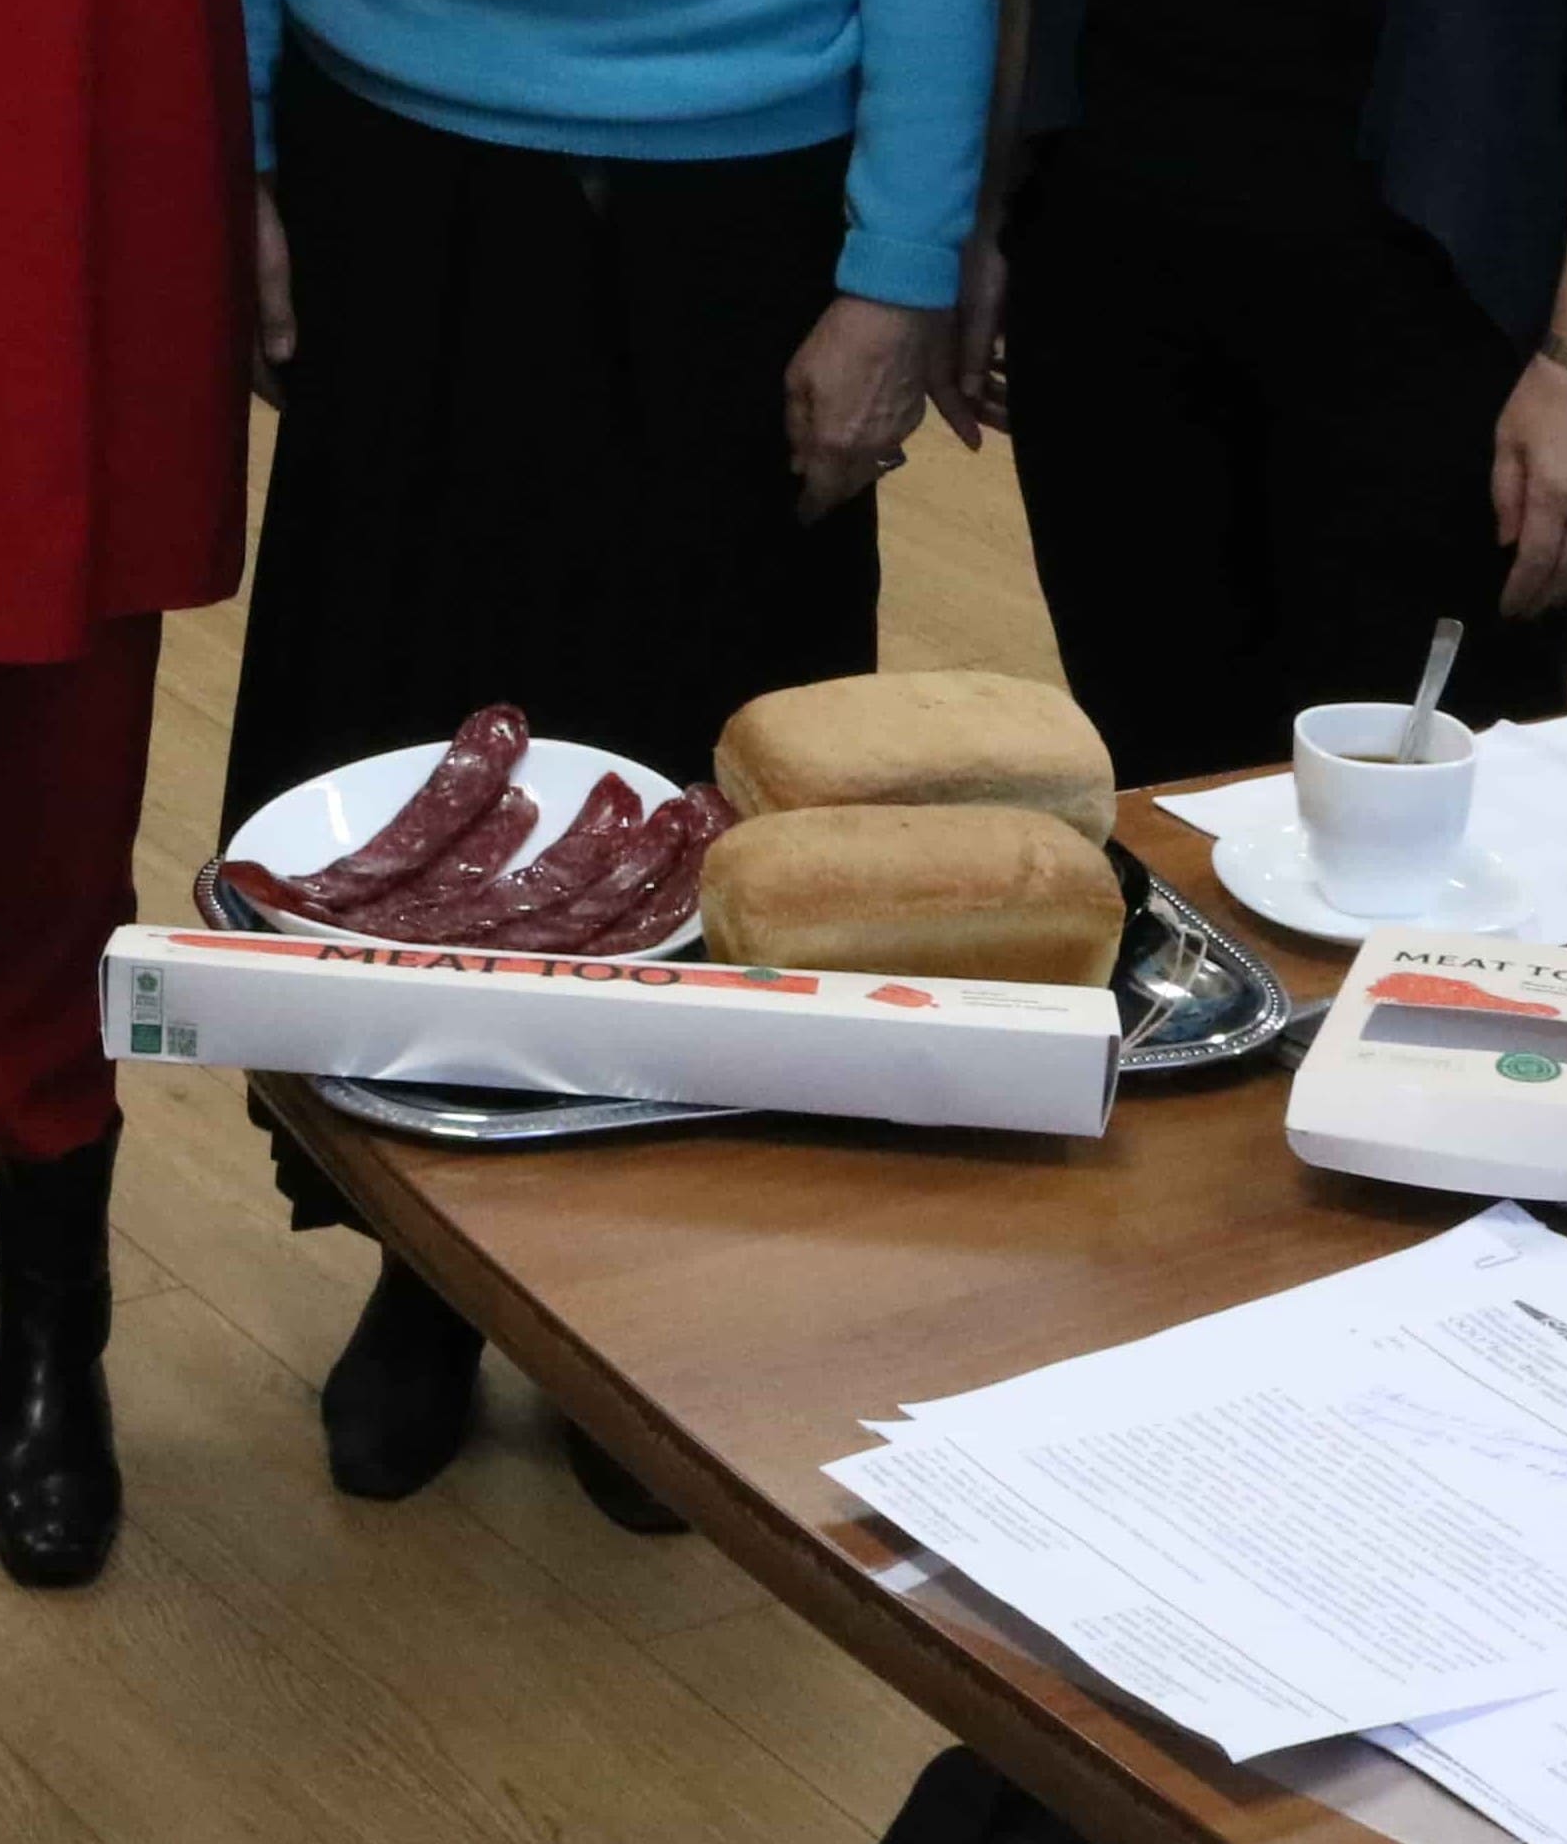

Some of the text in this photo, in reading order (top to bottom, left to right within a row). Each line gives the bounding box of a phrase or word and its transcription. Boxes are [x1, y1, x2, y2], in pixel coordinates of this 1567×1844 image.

[316, 944, 685, 987] MEAT TOO
[1393, 950, 1516, 973] MEAT
